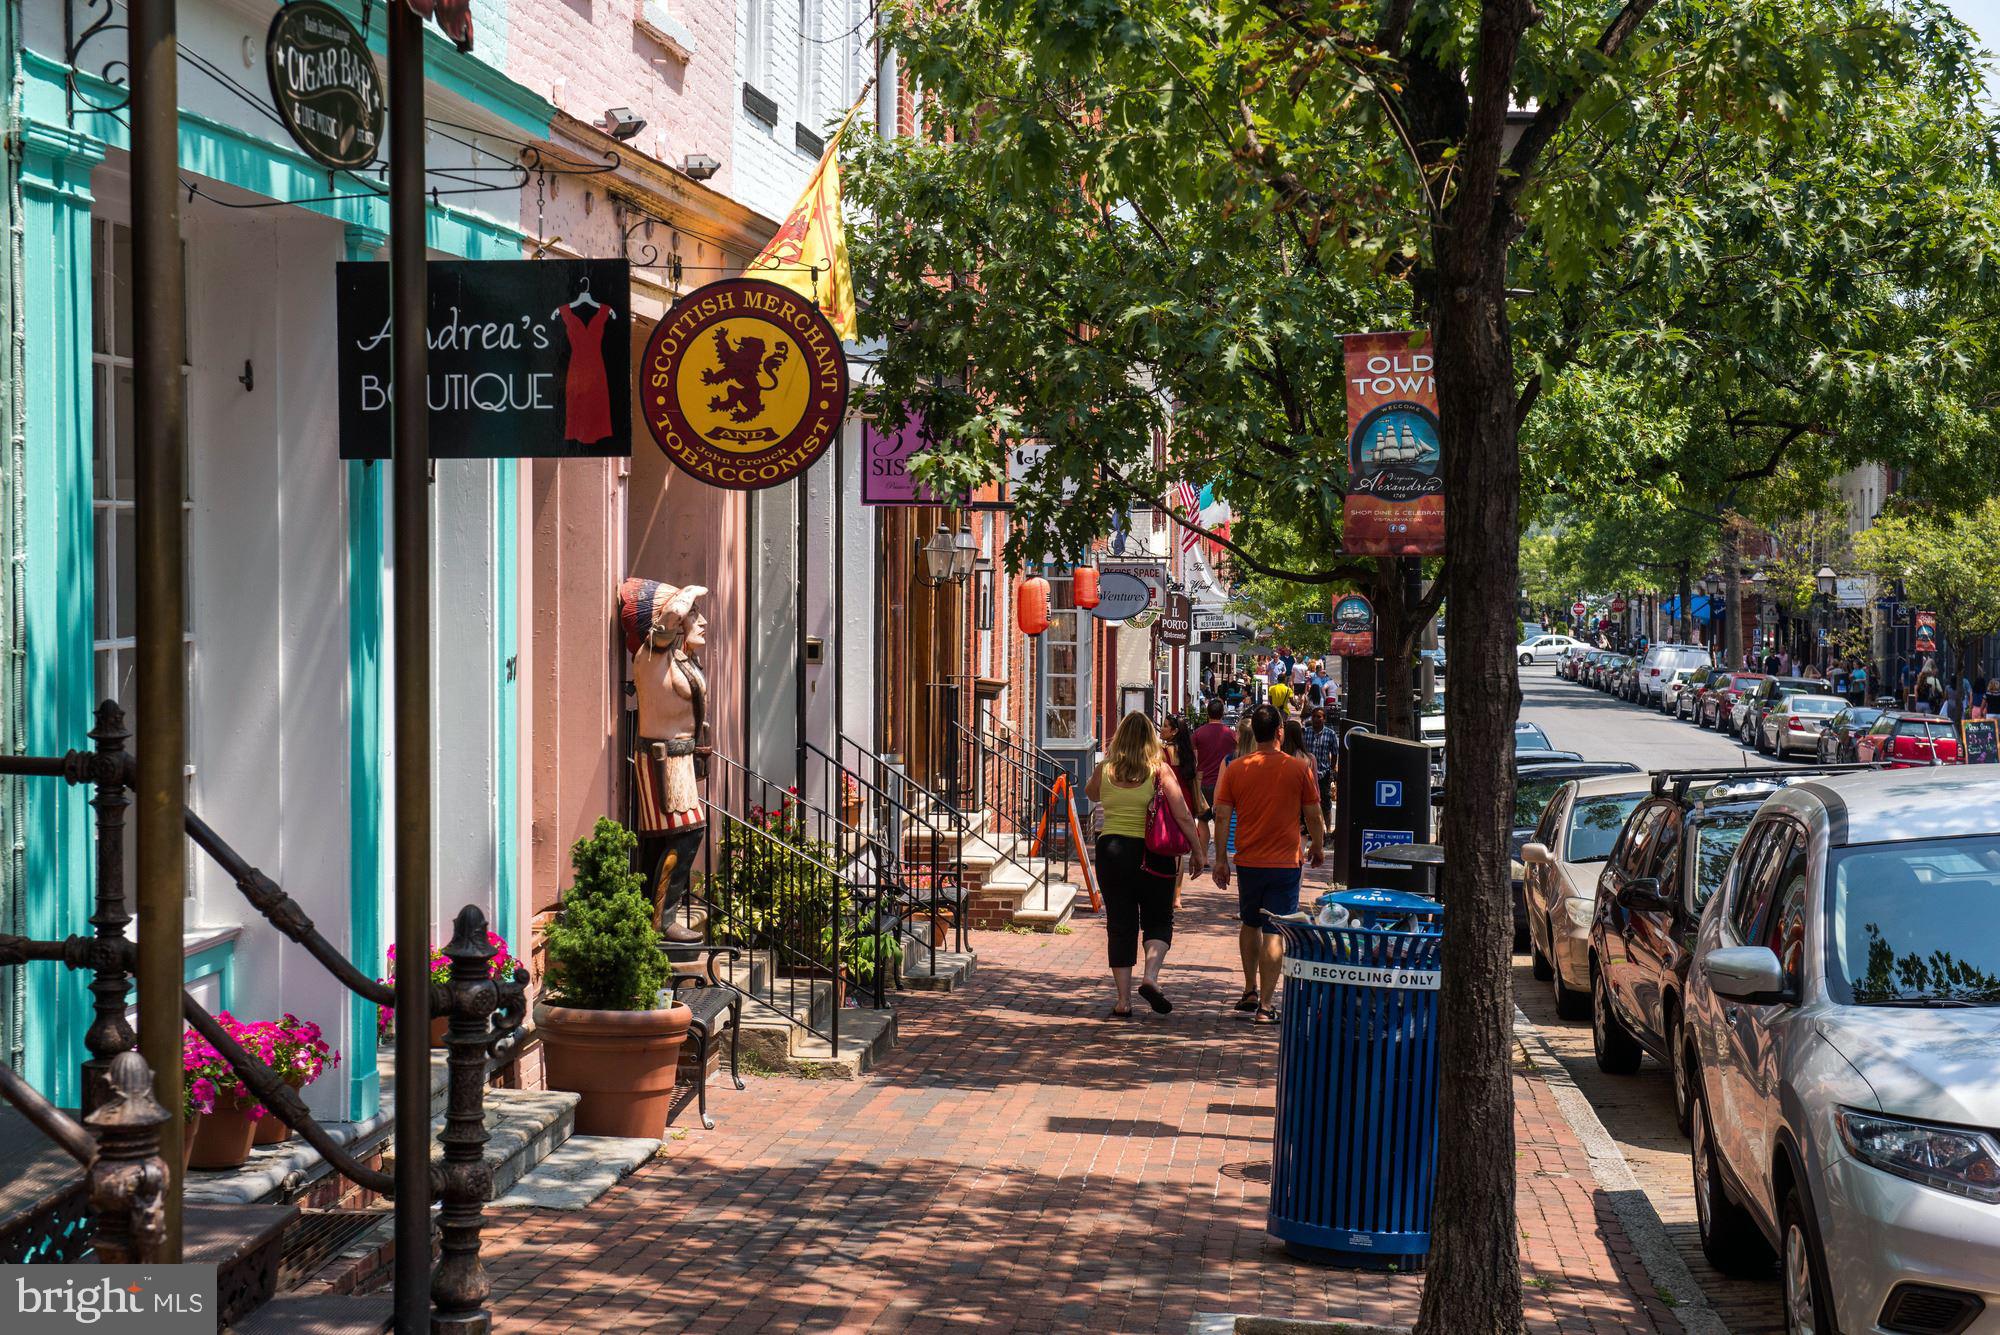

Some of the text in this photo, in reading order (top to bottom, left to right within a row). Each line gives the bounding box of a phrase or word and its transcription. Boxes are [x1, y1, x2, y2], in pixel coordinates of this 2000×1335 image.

[287, 46, 372, 113] CIGAR BAR
[294, 102, 301, 125] &
[356, 306, 550, 351] Adrea's
[651, 290, 838, 393] SCOTTISH MERCHANT
[1366, 354, 1434, 374] OLD
[361, 372, 554, 413] BUTIQUE
[1381, 403, 1421, 412] WELCOME
[718, 430, 767, 440] AND
[656, 412, 831, 483] TOBACCONIST
[695, 446, 788, 467] John Crouch
[1354, 471, 1442, 491] Alexandria
[1133, 567, 1160, 577] SPACE
[1190, 562, 1204, 571] The
[1190, 579, 1214, 592] Wharf
[1103, 591, 1146, 602] Ventures
[1171, 607, 1180, 618] IL
[1161, 619, 1188, 630] PORTO
[1352, 894, 1393, 902] GLASS
[1312, 966, 1434, 986] RECYCLING ONLY
